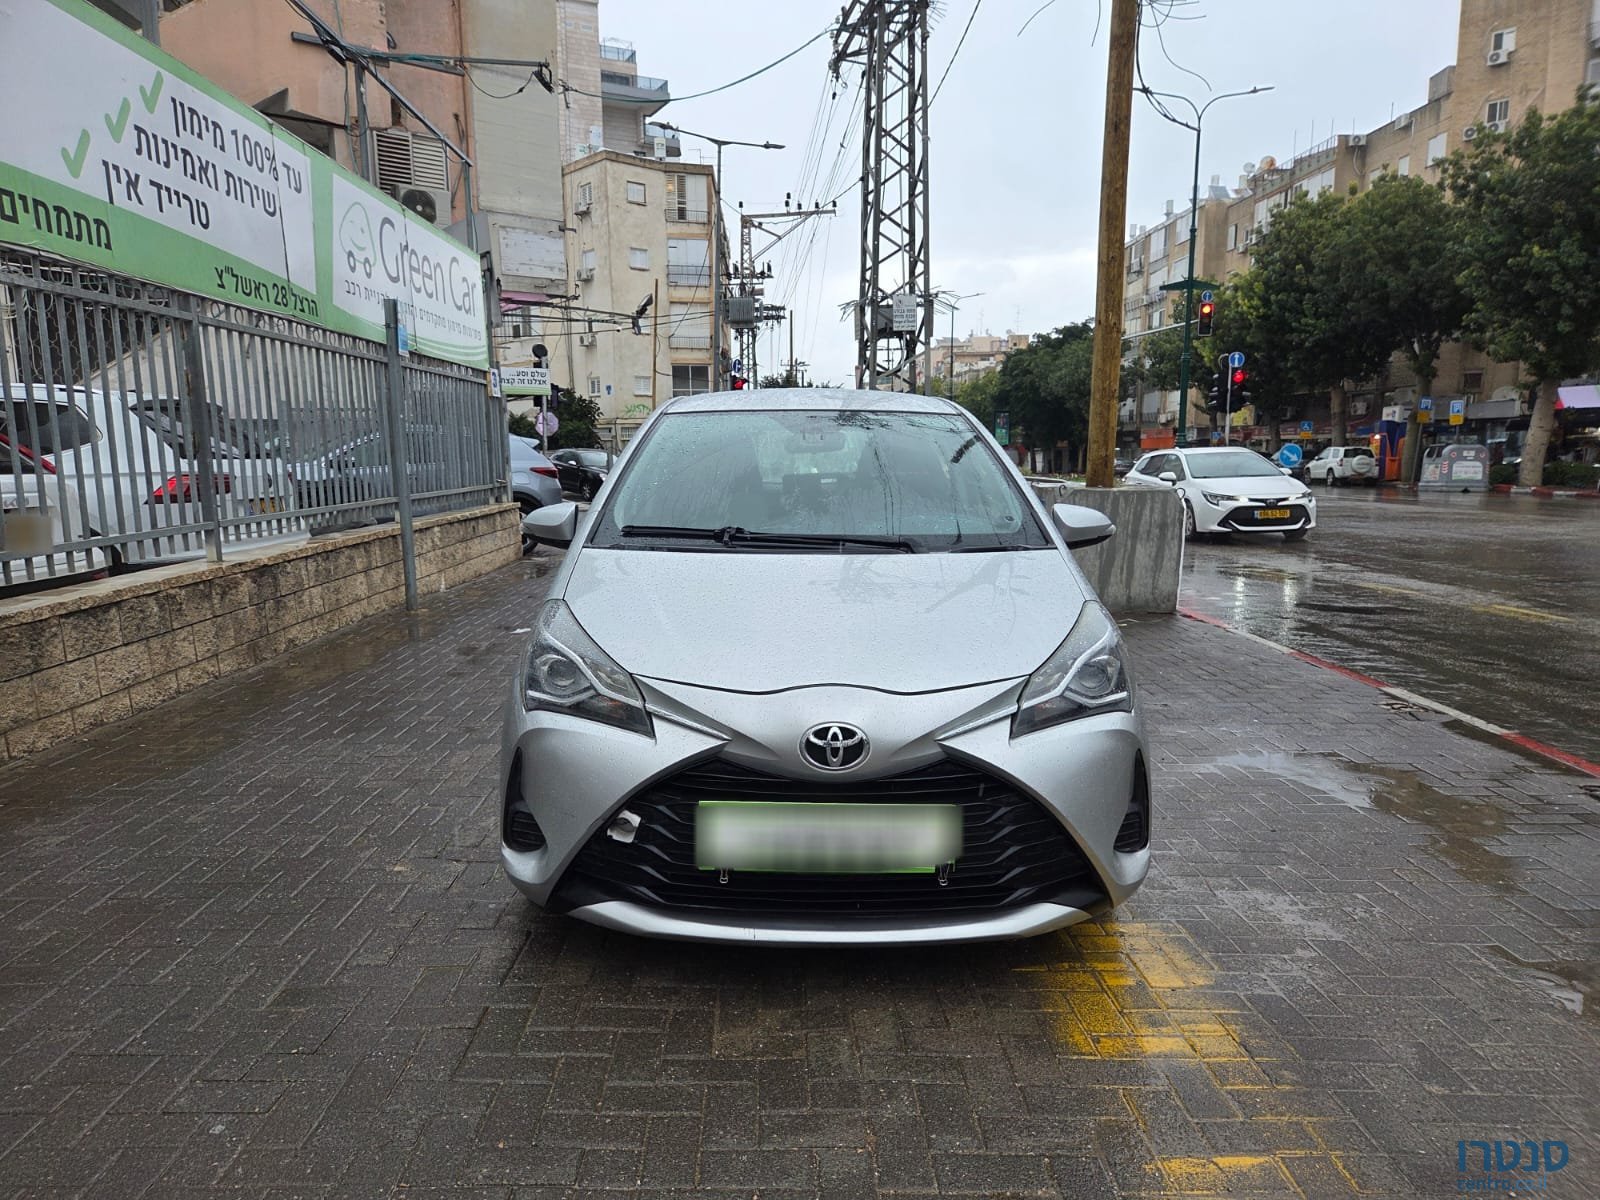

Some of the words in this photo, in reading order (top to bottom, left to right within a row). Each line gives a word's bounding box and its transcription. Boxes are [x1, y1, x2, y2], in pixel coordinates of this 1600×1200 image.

[170, 96, 226, 153] מימון
[133, 124, 219, 191] ואמינות
[231, 129, 279, 181] 100%
[282, 162, 303, 194] עד
[101, 159, 144, 205] אין
[149, 179, 210, 229] טרייד
[224, 169, 277, 217] שירות
[0, 187, 112, 251] מתמחים
[214, 265, 270, 303] ראשל"צ
[344, 279, 362, 298] רכב
[379, 216, 446, 304] Green
[449, 256, 477, 317] Car
[272, 282, 288, 308] 28
[289, 287, 318, 317] הרצל
[530, 370, 547, 378] שלם
